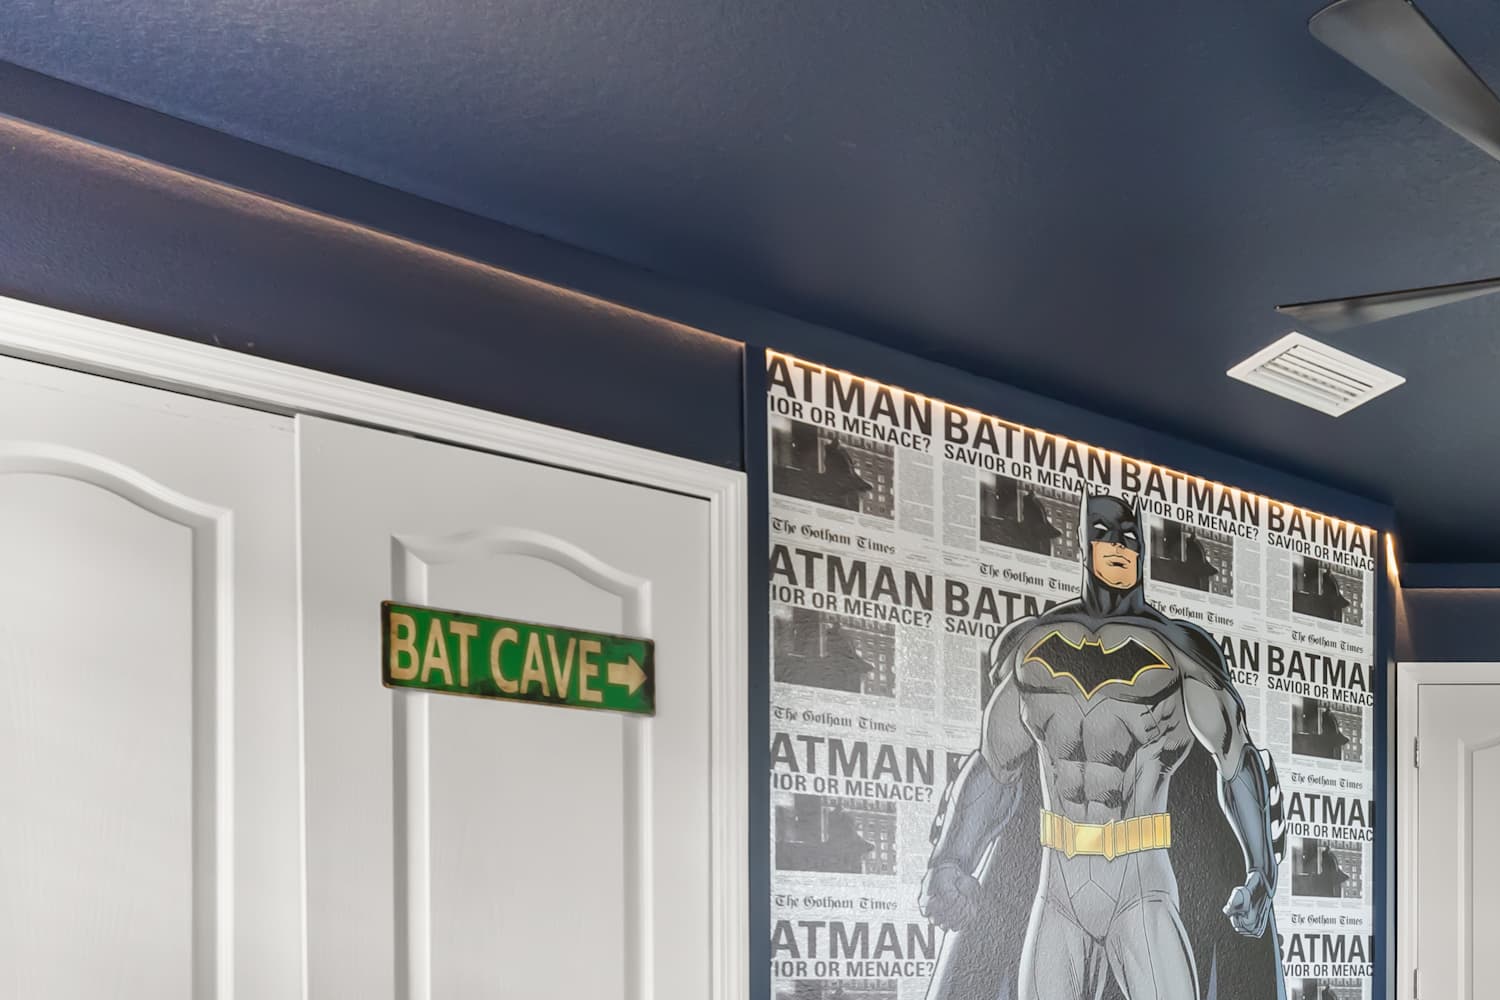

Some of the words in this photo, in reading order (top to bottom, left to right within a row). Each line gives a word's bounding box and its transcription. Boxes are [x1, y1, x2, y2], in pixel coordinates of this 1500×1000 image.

[810, 406, 836, 428] OR
[842, 414, 931, 453] MENACE?
[944, 404, 1111, 485] BATMAN
[944, 443, 1006, 473] SAVIOR
[1011, 462, 1032, 481] OR
[1121, 458, 1260, 526] BATMAN
[771, 516, 797, 535] The
[801, 524, 851, 546] Gotham
[856, 535, 896, 554] Times
[1176, 506, 1194, 524] OR
[1198, 513, 1259, 541] MENACE?
[1267, 532, 1311, 555] SAVIOR
[1314, 545, 1329, 561] OR
[979, 562, 1000, 578] The
[1002, 568, 1044, 587] Gotham
[1048, 577, 1081, 594] Times
[812, 591, 838, 612] OR
[843, 597, 932, 628] MENACE?
[1169, 604, 1203, 620] Gotham
[1207, 611, 1234, 627] Times
[1291, 630, 1306, 644] The
[1308, 633, 1337, 649] Gotham
[1340, 640, 1364, 654] Times
[390, 612, 478, 687] BAT
[490, 627, 603, 702] CAVE
[1267, 676, 1311, 696] SAVIOR
[1314, 684, 1329, 699] OR
[773, 704, 799, 721] The
[802, 709, 852, 728] Gotham
[857, 715, 897, 733] Times
[813, 775, 839, 795] OR
[845, 780, 934, 803] MENACE?
[1291, 771, 1306, 784] The
[1307, 774, 1337, 787] Gotham
[1339, 777, 1364, 790] Times
[1313, 825, 1329, 838] OR
[775, 894, 799, 910] The
[803, 895, 854, 911] Gotham
[859, 896, 898, 911] Times
[1291, 913, 1306, 926] The
[1307, 914, 1337, 927] Gotham
[1339, 915, 1364, 926] Times
[814, 960, 840, 978] OR
[846, 960, 934, 978] MENACE?
[1313, 964, 1329, 977] OR
